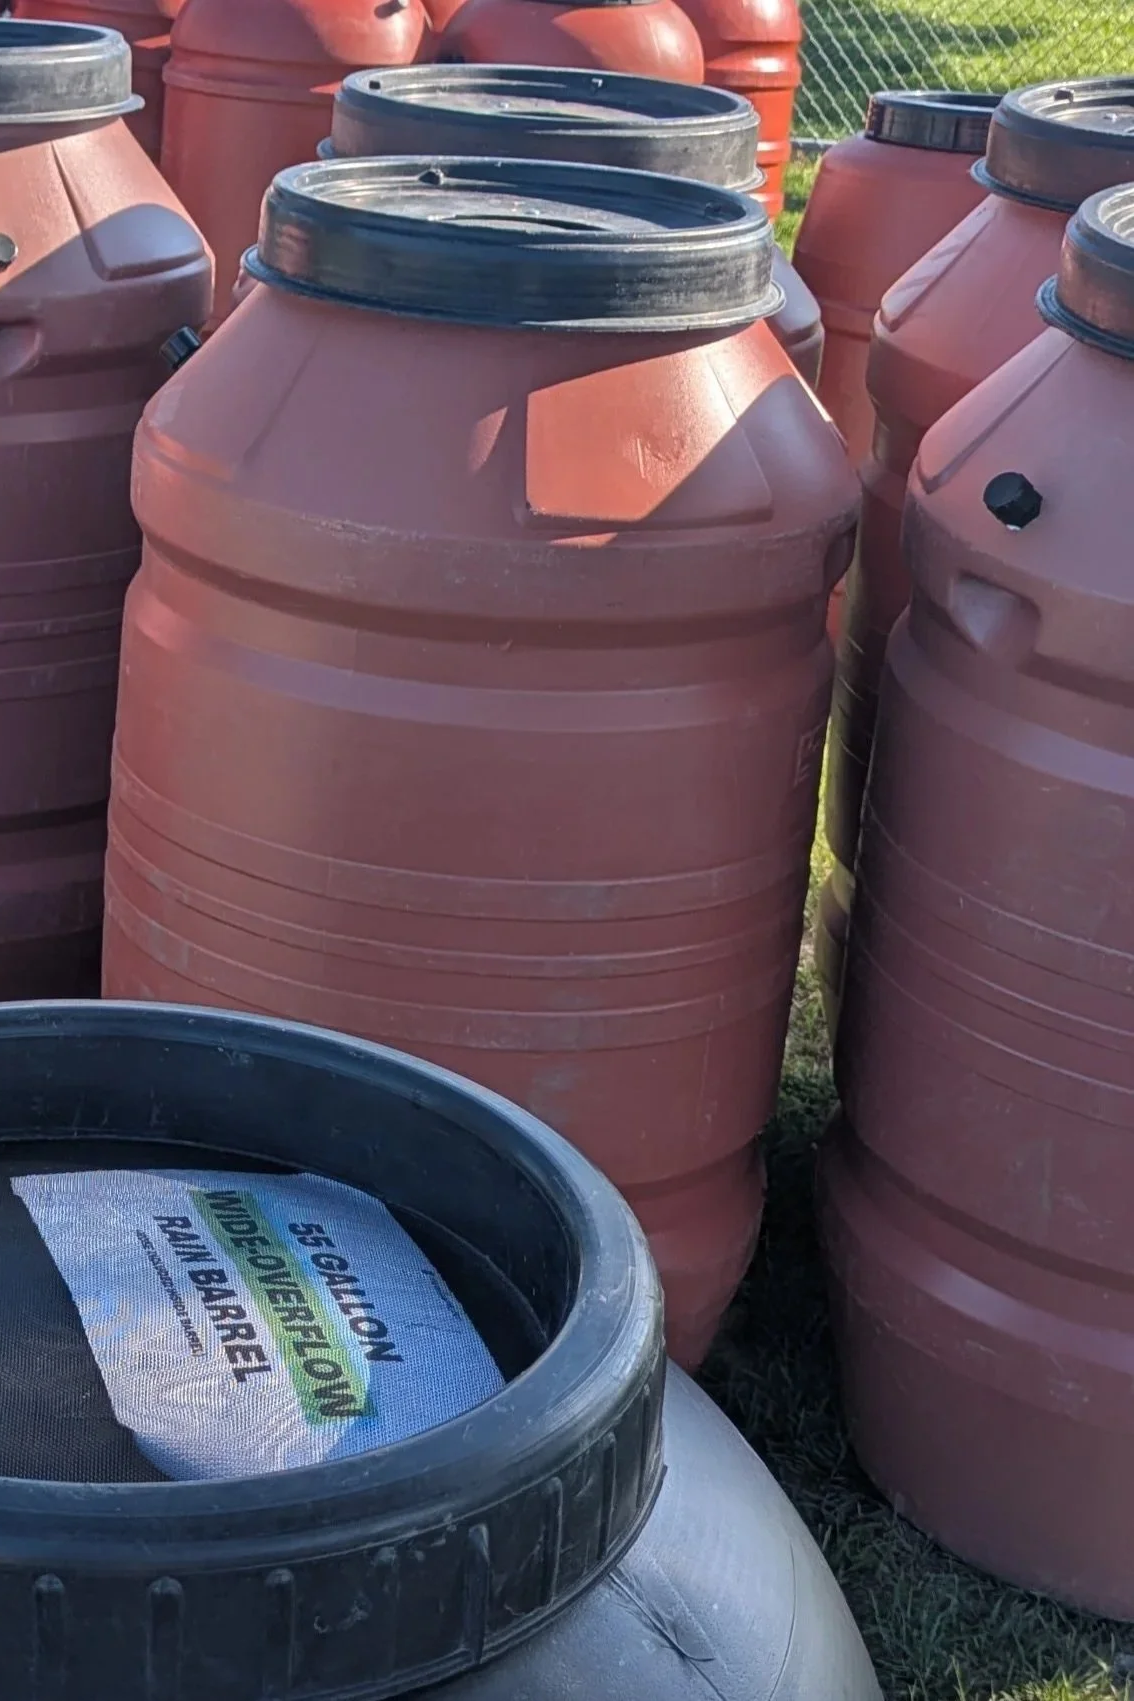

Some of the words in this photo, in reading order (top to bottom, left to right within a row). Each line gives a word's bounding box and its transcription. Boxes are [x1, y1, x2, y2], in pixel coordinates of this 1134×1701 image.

[153, 1216, 217, 1263] RAIN
[187, 1269, 272, 1383] BARREL
[204, 1190, 366, 1417] WIDE-OVERFLOW
[288, 1223, 335, 1248] 55
[310, 1252, 404, 1362] GALLON
